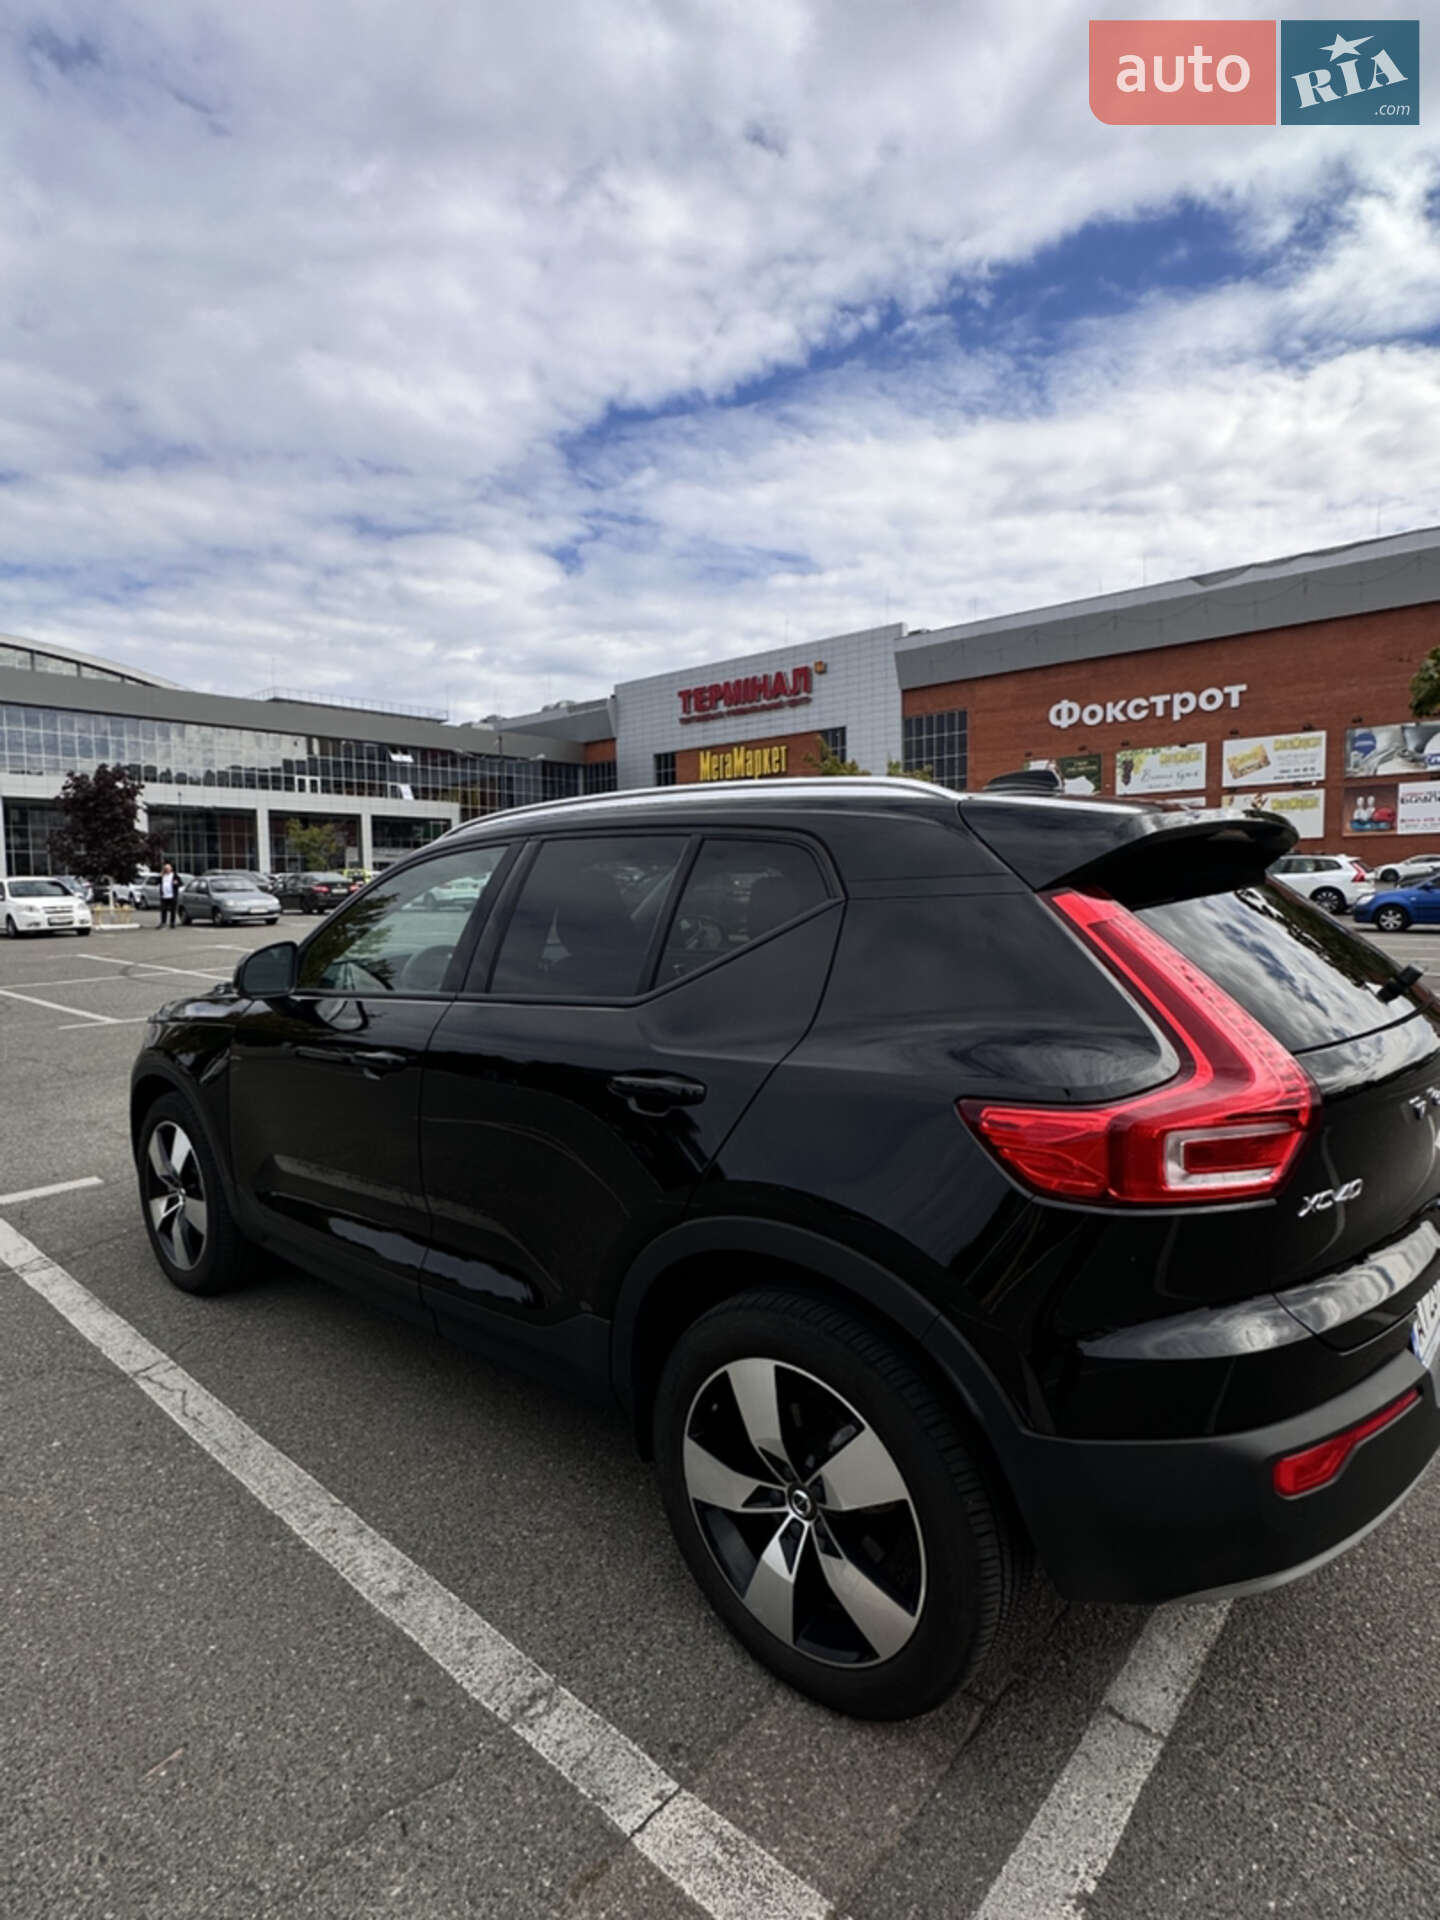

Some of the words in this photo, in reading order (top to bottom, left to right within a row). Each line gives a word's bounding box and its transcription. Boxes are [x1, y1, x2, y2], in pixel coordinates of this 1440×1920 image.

[678, 665, 813, 715] ТЕРМІНАЛ
[1048, 683, 1249, 730] Фокстрот
[699, 745, 788, 781] МегаМаркет
[1297, 1177, 1363, 1217] XC40
